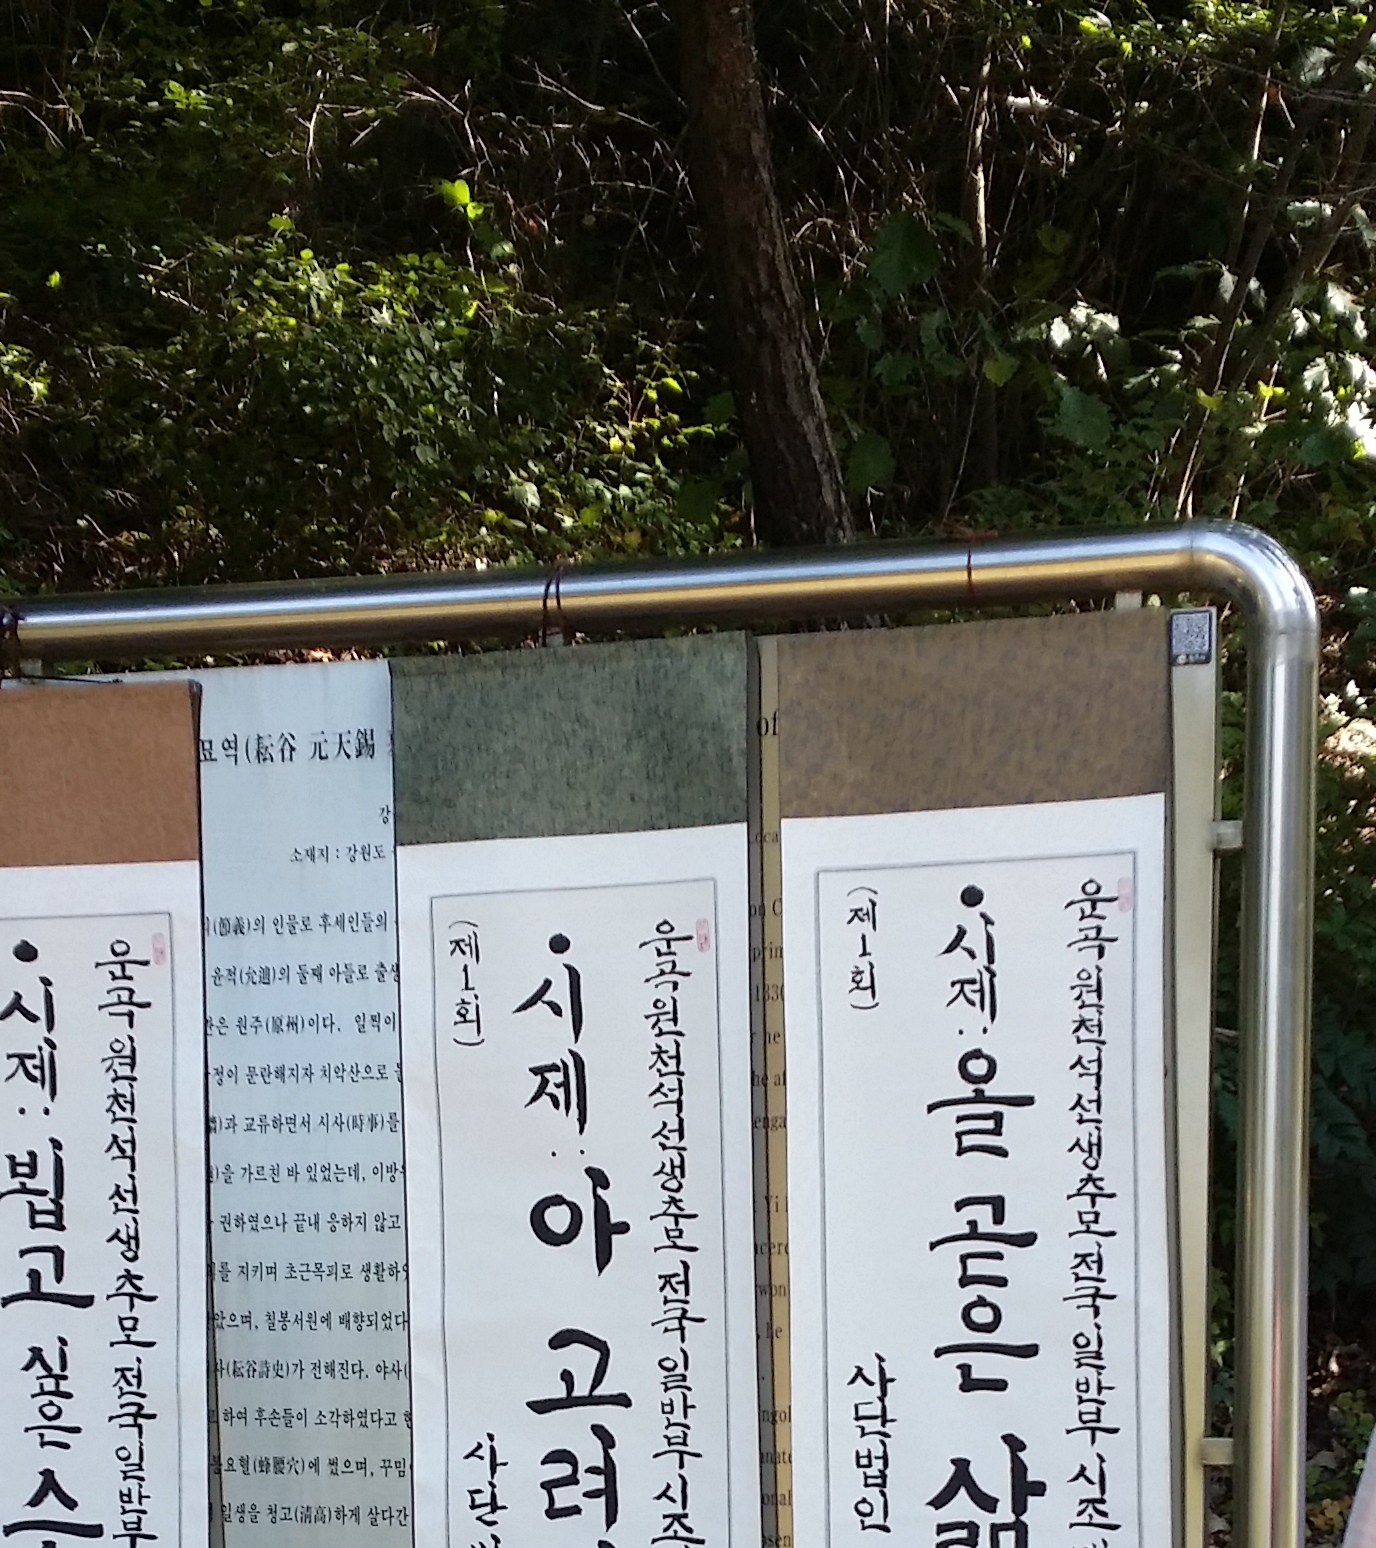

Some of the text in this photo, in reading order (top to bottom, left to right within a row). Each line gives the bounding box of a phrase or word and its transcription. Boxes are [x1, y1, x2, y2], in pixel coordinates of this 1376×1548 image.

[246, 1063, 314, 1085] 문란해지자
[320, 1062, 389, 1083] 치악산으로
[244, 1113, 311, 1134] 교류하면서
[241, 1163, 280, 1184] 가르친
[287, 1163, 300, 1183] 바
[219, 1212, 401, 1233] 권하였으나 끝내 응하지 않고
[237, 1261, 277, 1282] 지키며
[285, 1262, 354, 1282] 초근목피로
[265, 1311, 332, 1332] 칠봉서원에
[254, 1407, 308, 1428] 후손들이
[314, 1408, 398, 1429] 소각하였다고
[367, 1506, 410, 1527] 살다간
